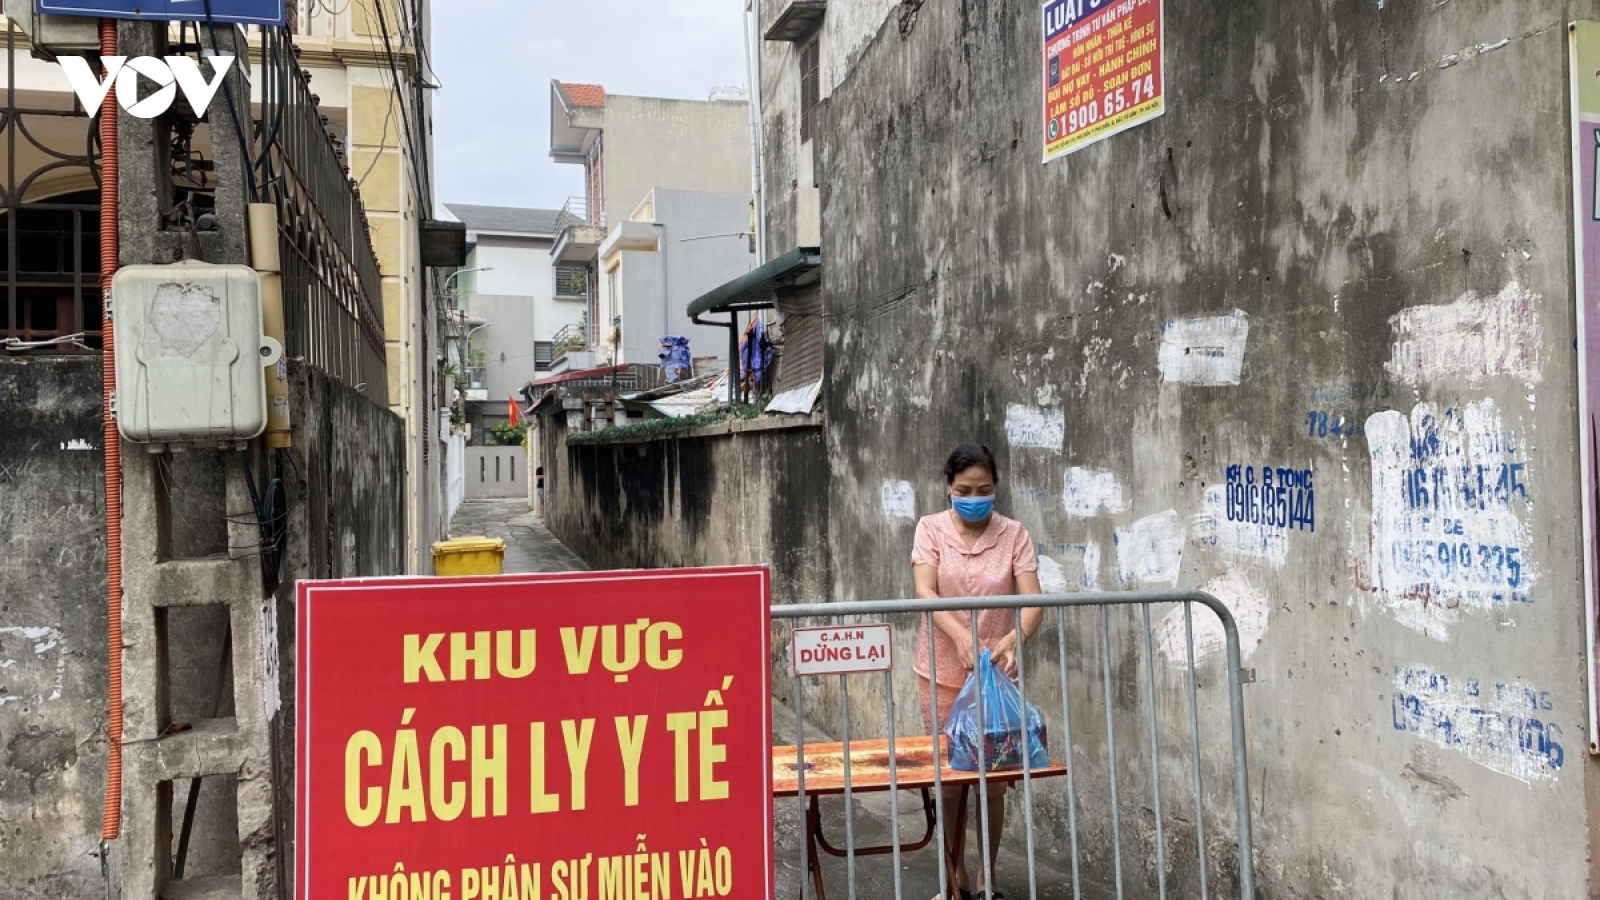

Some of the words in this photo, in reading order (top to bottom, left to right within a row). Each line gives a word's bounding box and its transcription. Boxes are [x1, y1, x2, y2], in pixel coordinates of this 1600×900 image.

[1050, 100, 1066, 118] LÀM
[1103, 72, 1128, 94] SOẠN
[1131, 59, 1151, 79] ĐƠN
[1062, 80, 1073, 98] NỢ
[1075, 72, 1090, 88] VAY
[1099, 54, 1123, 78] HÀNH
[1126, 37, 1156, 63] CHÍNH
[1060, 73, 1153, 136] 1900.65.74
[403, 628, 536, 683] KHU
[560, 618, 683, 683] VỰC
[801, 643, 851, 663] DỪNG
[856, 645, 885, 662] LẠI
[821, 631, 864, 641] C.A.H.N
[345, 708, 508, 827] CÁCH
[530, 718, 596, 814] LY
[615, 714, 649, 807] Y
[667, 675, 734, 803] TẾ
[599, 833, 671, 900] MIỄN
[680, 838, 732, 898] VÀO
